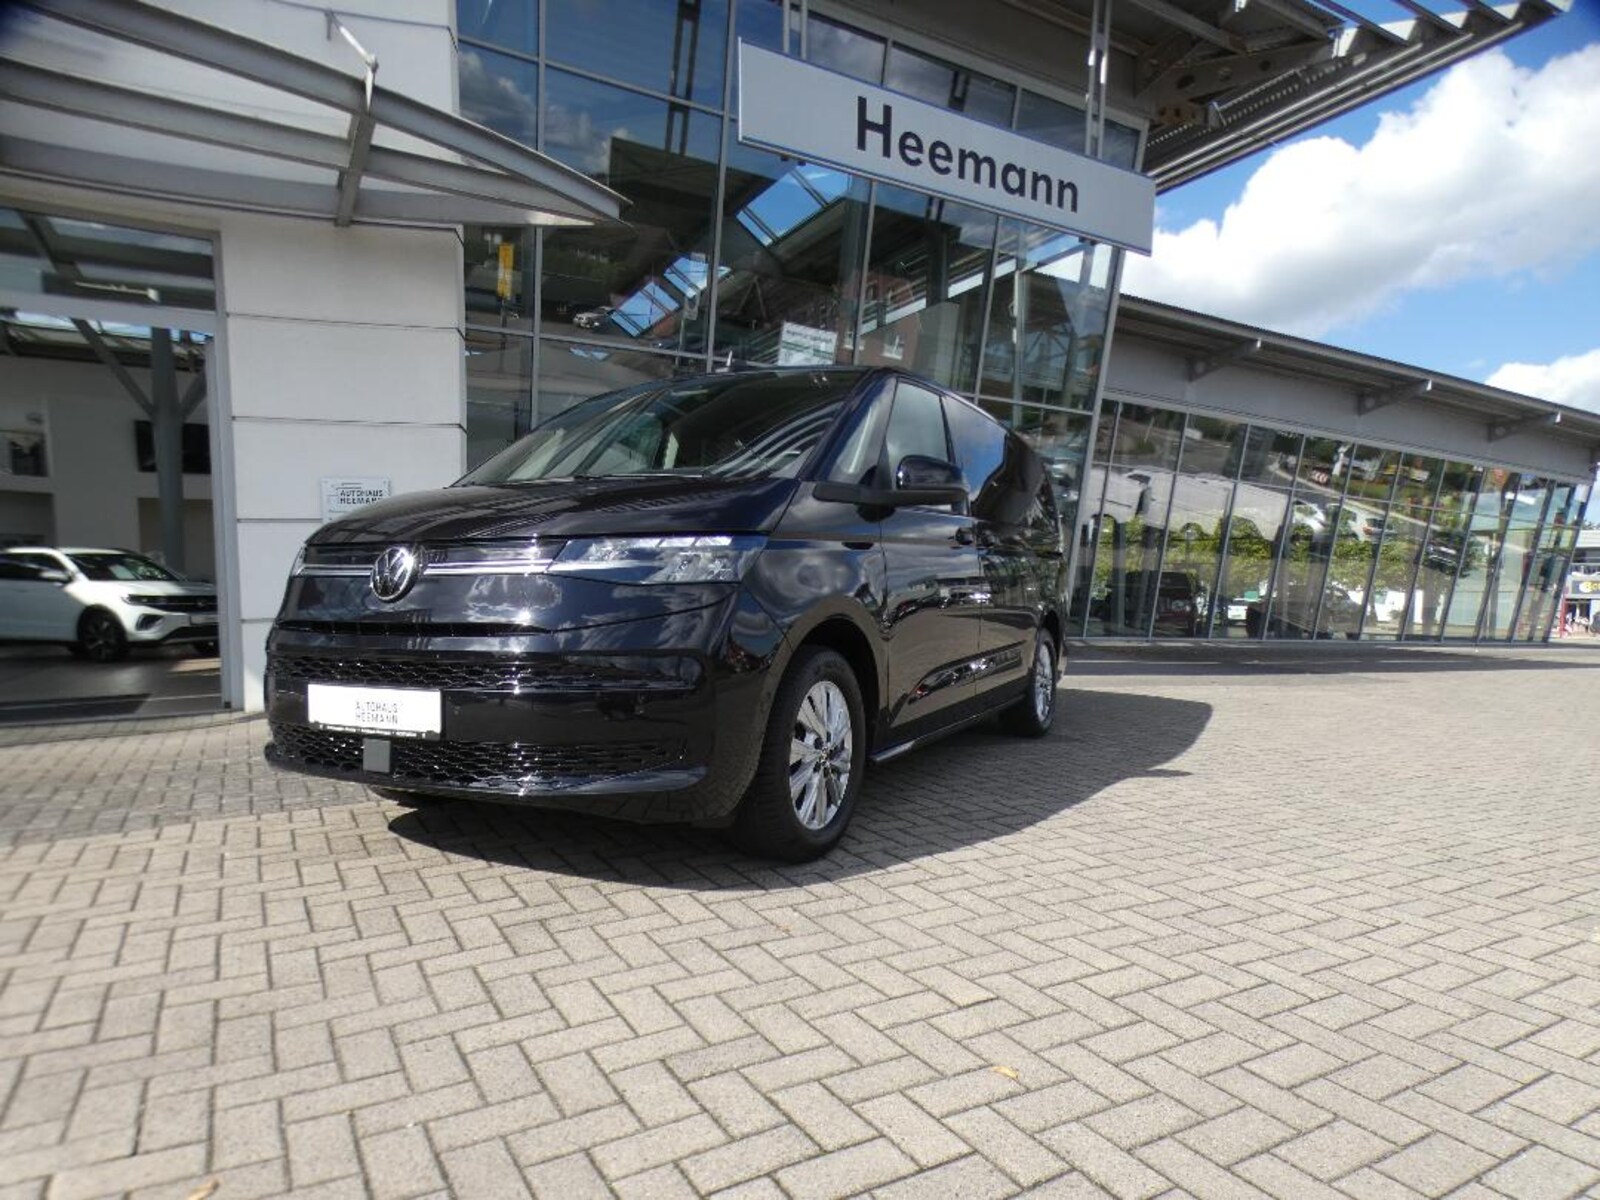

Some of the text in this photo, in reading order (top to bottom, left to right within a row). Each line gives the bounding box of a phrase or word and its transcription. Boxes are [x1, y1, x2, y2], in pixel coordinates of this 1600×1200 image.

[856, 95, 1079, 214] Heemann
[340, 489, 383, 497] AUTOHAUS
[355, 701, 398, 713] AUTOHAUS
[355, 711, 398, 725] HEEMANN
